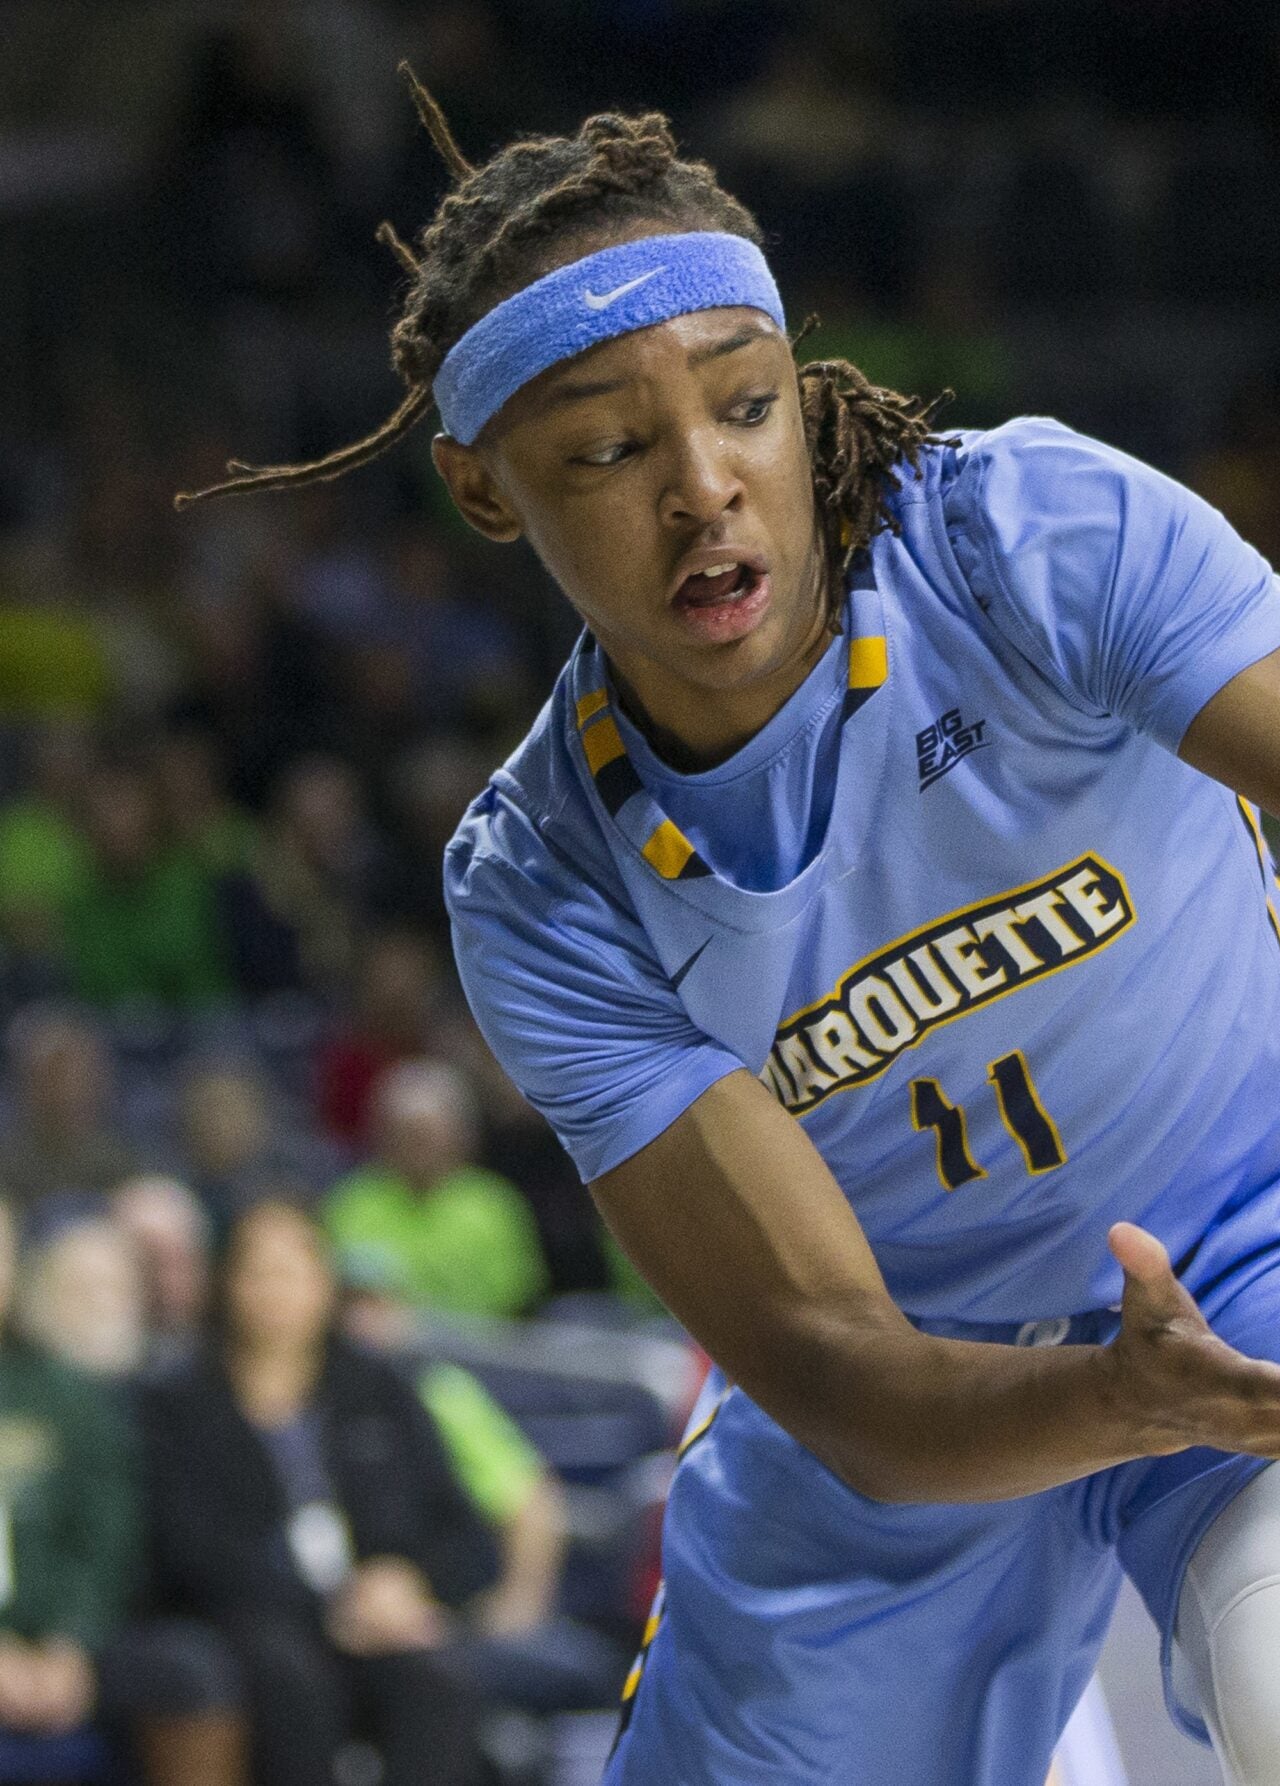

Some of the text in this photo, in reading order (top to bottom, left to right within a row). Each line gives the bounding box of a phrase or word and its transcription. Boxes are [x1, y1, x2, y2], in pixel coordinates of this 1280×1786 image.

[915, 707, 962, 757] BIG
[918, 719, 987, 780] EAST
[757, 866, 1126, 1107] ARQUETTE
[908, 1049, 1068, 1192] 11
